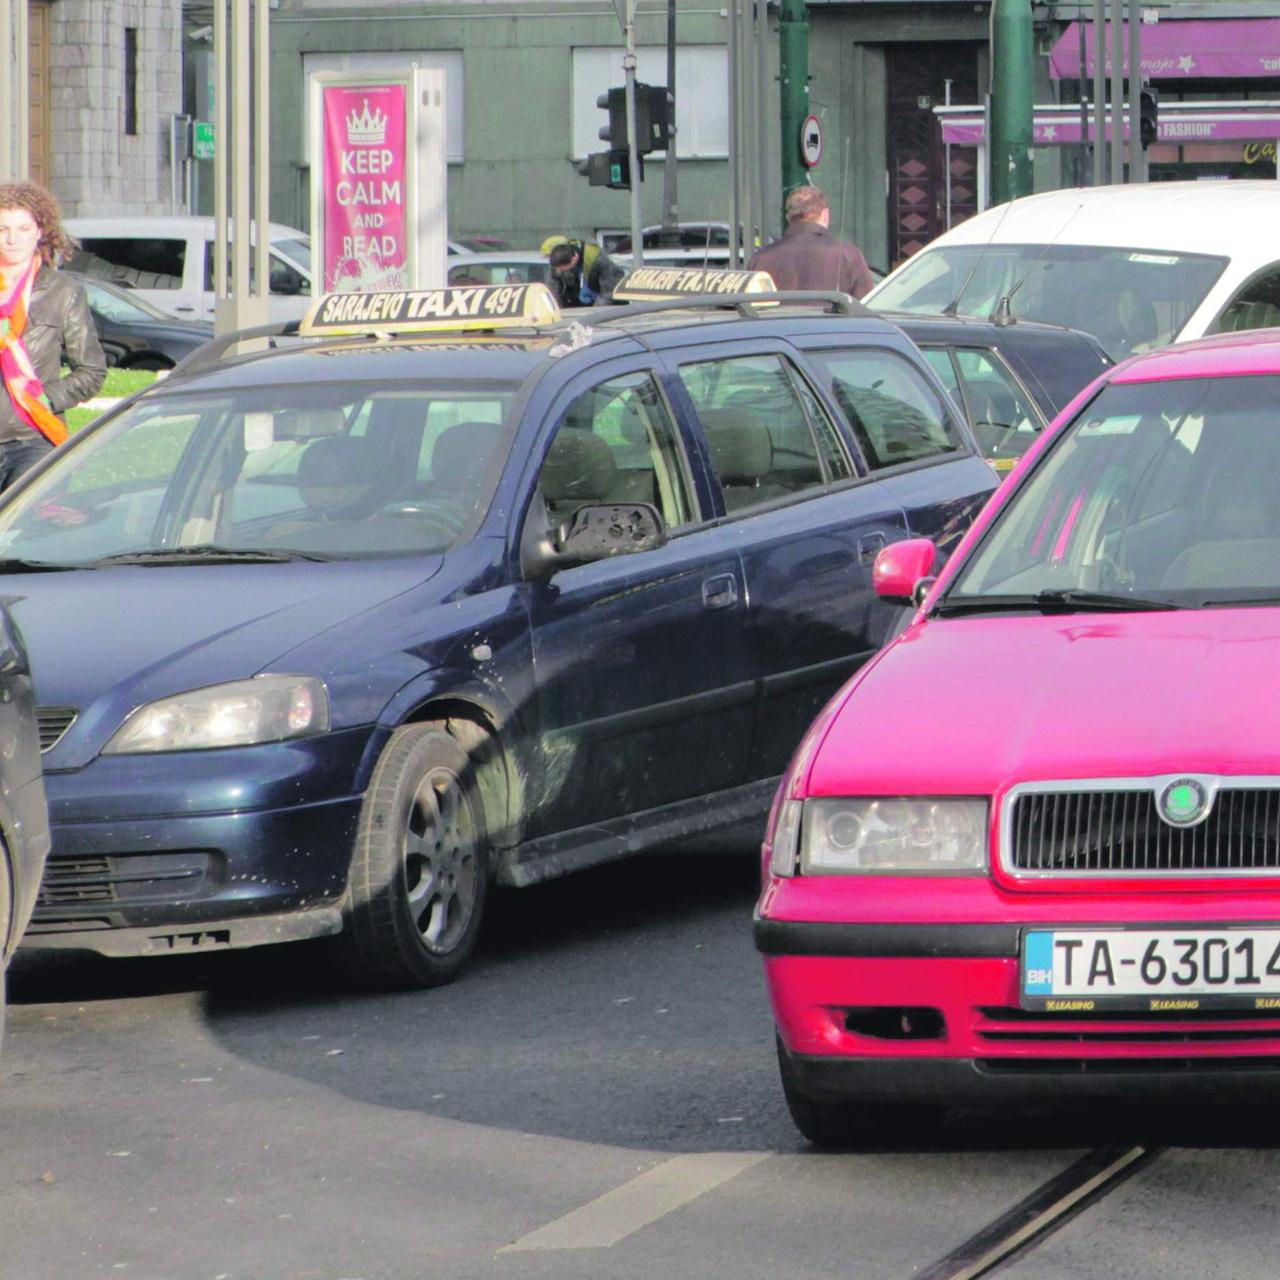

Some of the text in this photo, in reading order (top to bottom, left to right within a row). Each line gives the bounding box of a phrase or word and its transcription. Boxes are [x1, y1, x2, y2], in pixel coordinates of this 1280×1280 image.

[342, 150, 394, 175] KEEP
[336, 180, 401, 206] CALM
[352, 213, 384, 229] AND
[343, 235, 397, 260] READ
[322, 285, 526, 323] SARAJEVO TAXI 491
[1027, 970, 1052, 985] BIH
[1055, 1000, 1095, 1011] LEASING
[1160, 999, 1200, 1011] LEASING
